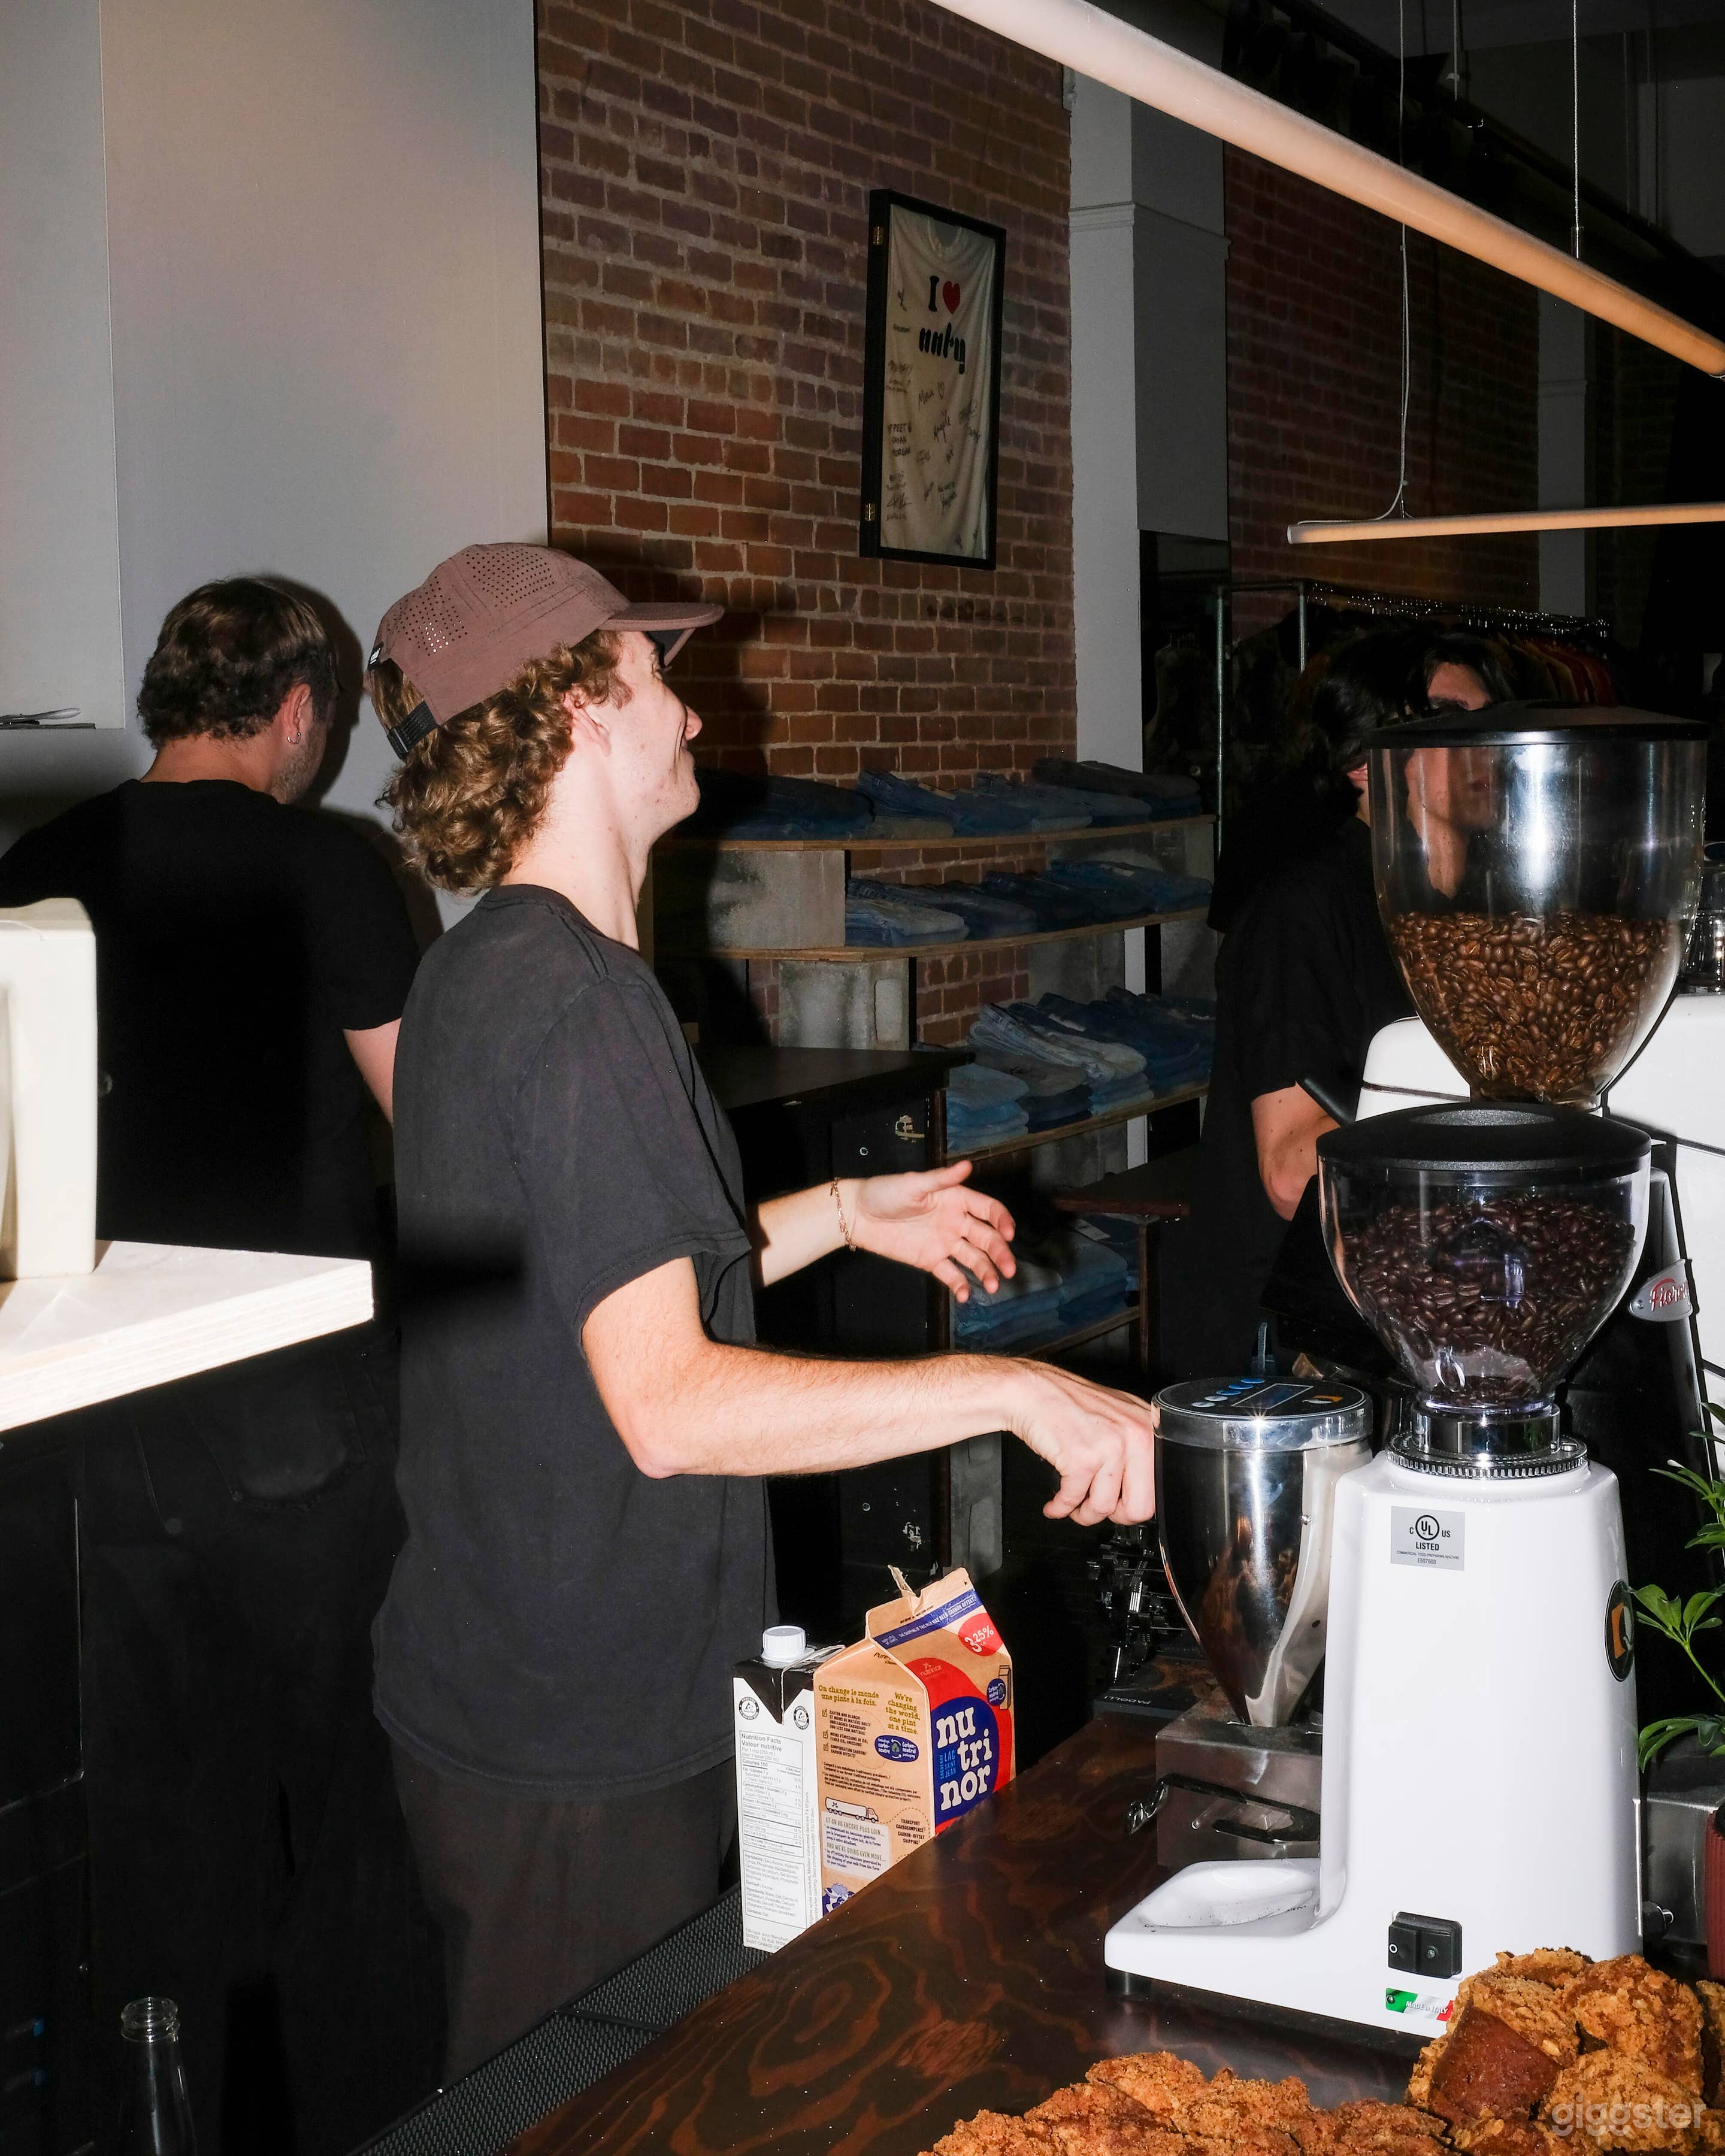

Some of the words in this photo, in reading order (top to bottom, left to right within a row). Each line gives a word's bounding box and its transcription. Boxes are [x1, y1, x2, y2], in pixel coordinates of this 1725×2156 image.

[928, 275, 939, 311] I
[1421, 1521, 1433, 1536] UL
[1416, 1542, 1439, 1551] LISTED
[948, 1605, 962, 1616] CARBON
[964, 1625, 994, 1653] 3.25%
[829, 1686, 849, 1696] change
[858, 1690, 879, 1698] monde
[895, 1692, 913, 1702] We're
[834, 1695, 849, 1703] pinte
[885, 1707, 897, 1715] the
[888, 1700, 918, 1713] changing
[902, 1718, 916, 1727] pint
[936, 1706, 975, 1749] nu
[901, 1725, 919, 1735] time.
[742, 1733, 765, 1742] Nutrition
[944, 1749, 956, 1762] LAC
[957, 1728, 992, 1772] tri
[945, 1760, 956, 1770] SAINT
[945, 1768, 956, 1779] JEAN
[940, 1764, 991, 1811] nor
[1405, 2000, 1424, 2011] MADE
[1431, 2006, 1449, 2015] ITALY
